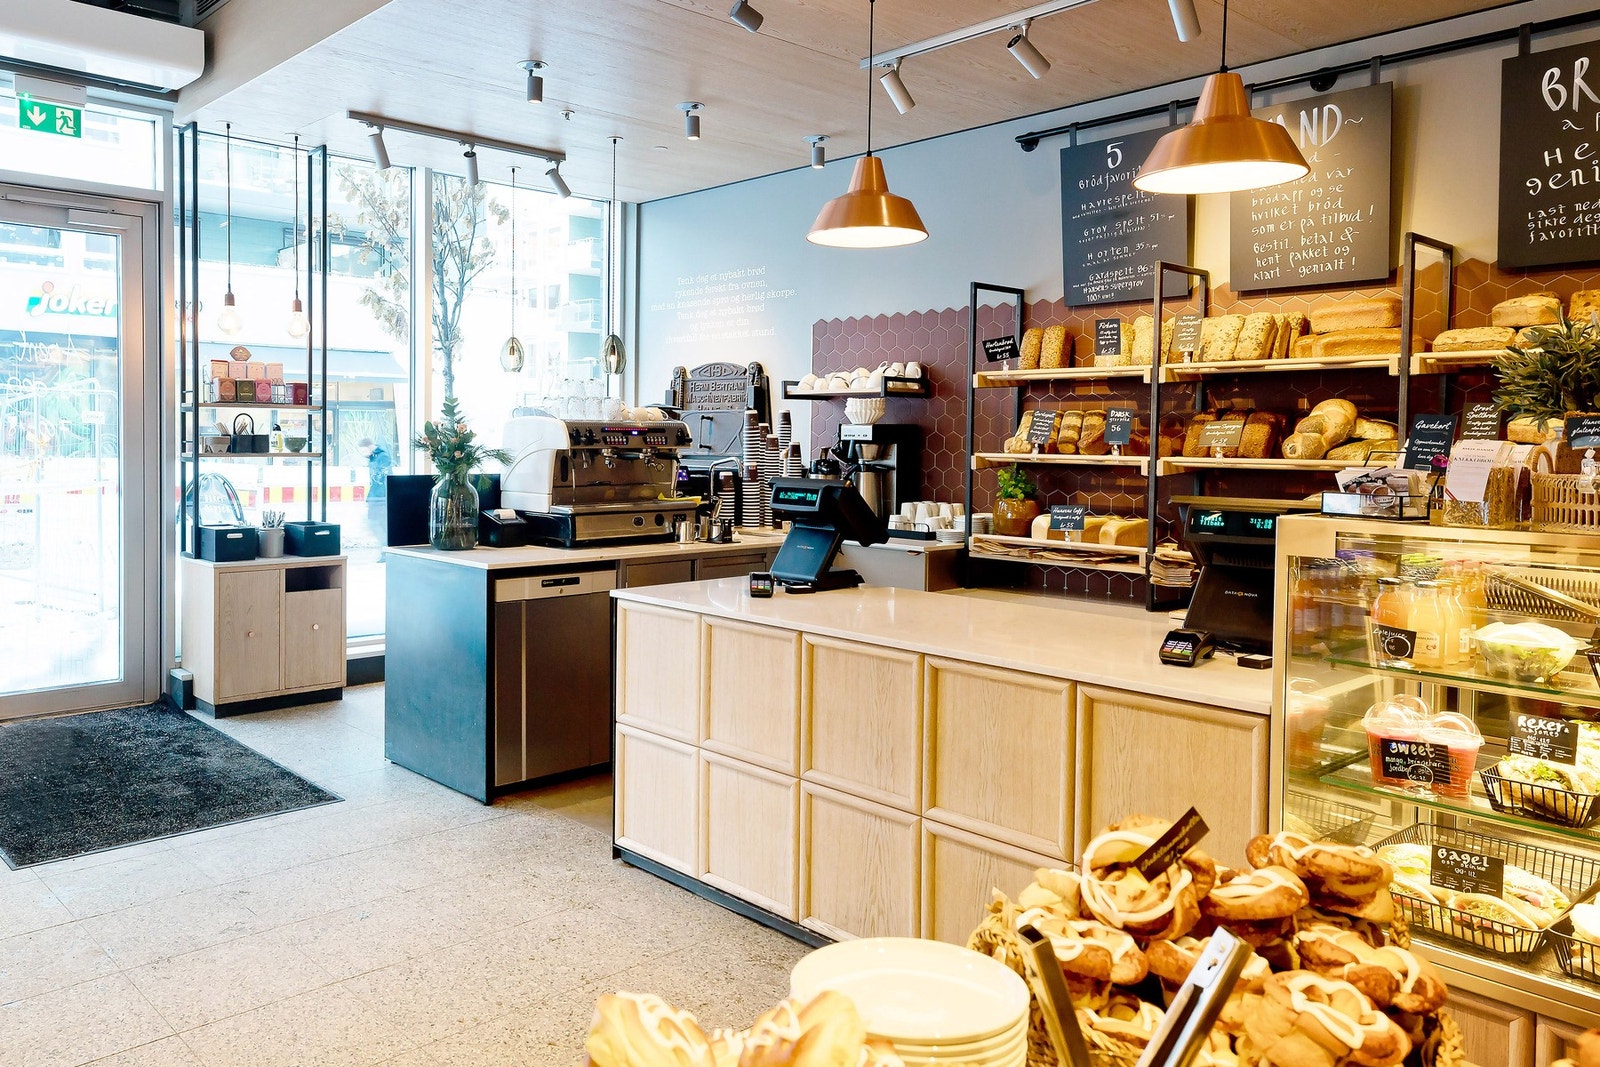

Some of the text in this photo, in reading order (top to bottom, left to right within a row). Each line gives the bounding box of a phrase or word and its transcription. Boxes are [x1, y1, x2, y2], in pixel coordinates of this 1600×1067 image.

[1106, 142, 1124, 169] 5
[1310, 188, 1323, 197] og
[1329, 184, 1344, 193] se
[1251, 223, 1275, 237] som
[1280, 219, 1295, 231] er
[1528, 216, 1567, 230] sikre
[1301, 232, 1334, 246] betal
[1340, 226, 1360, 243] &
[1256, 245, 1350, 268] hent pakket og
[1415, 420, 1452, 430] Gavekort
[1437, 848, 1490, 867] Bagel
